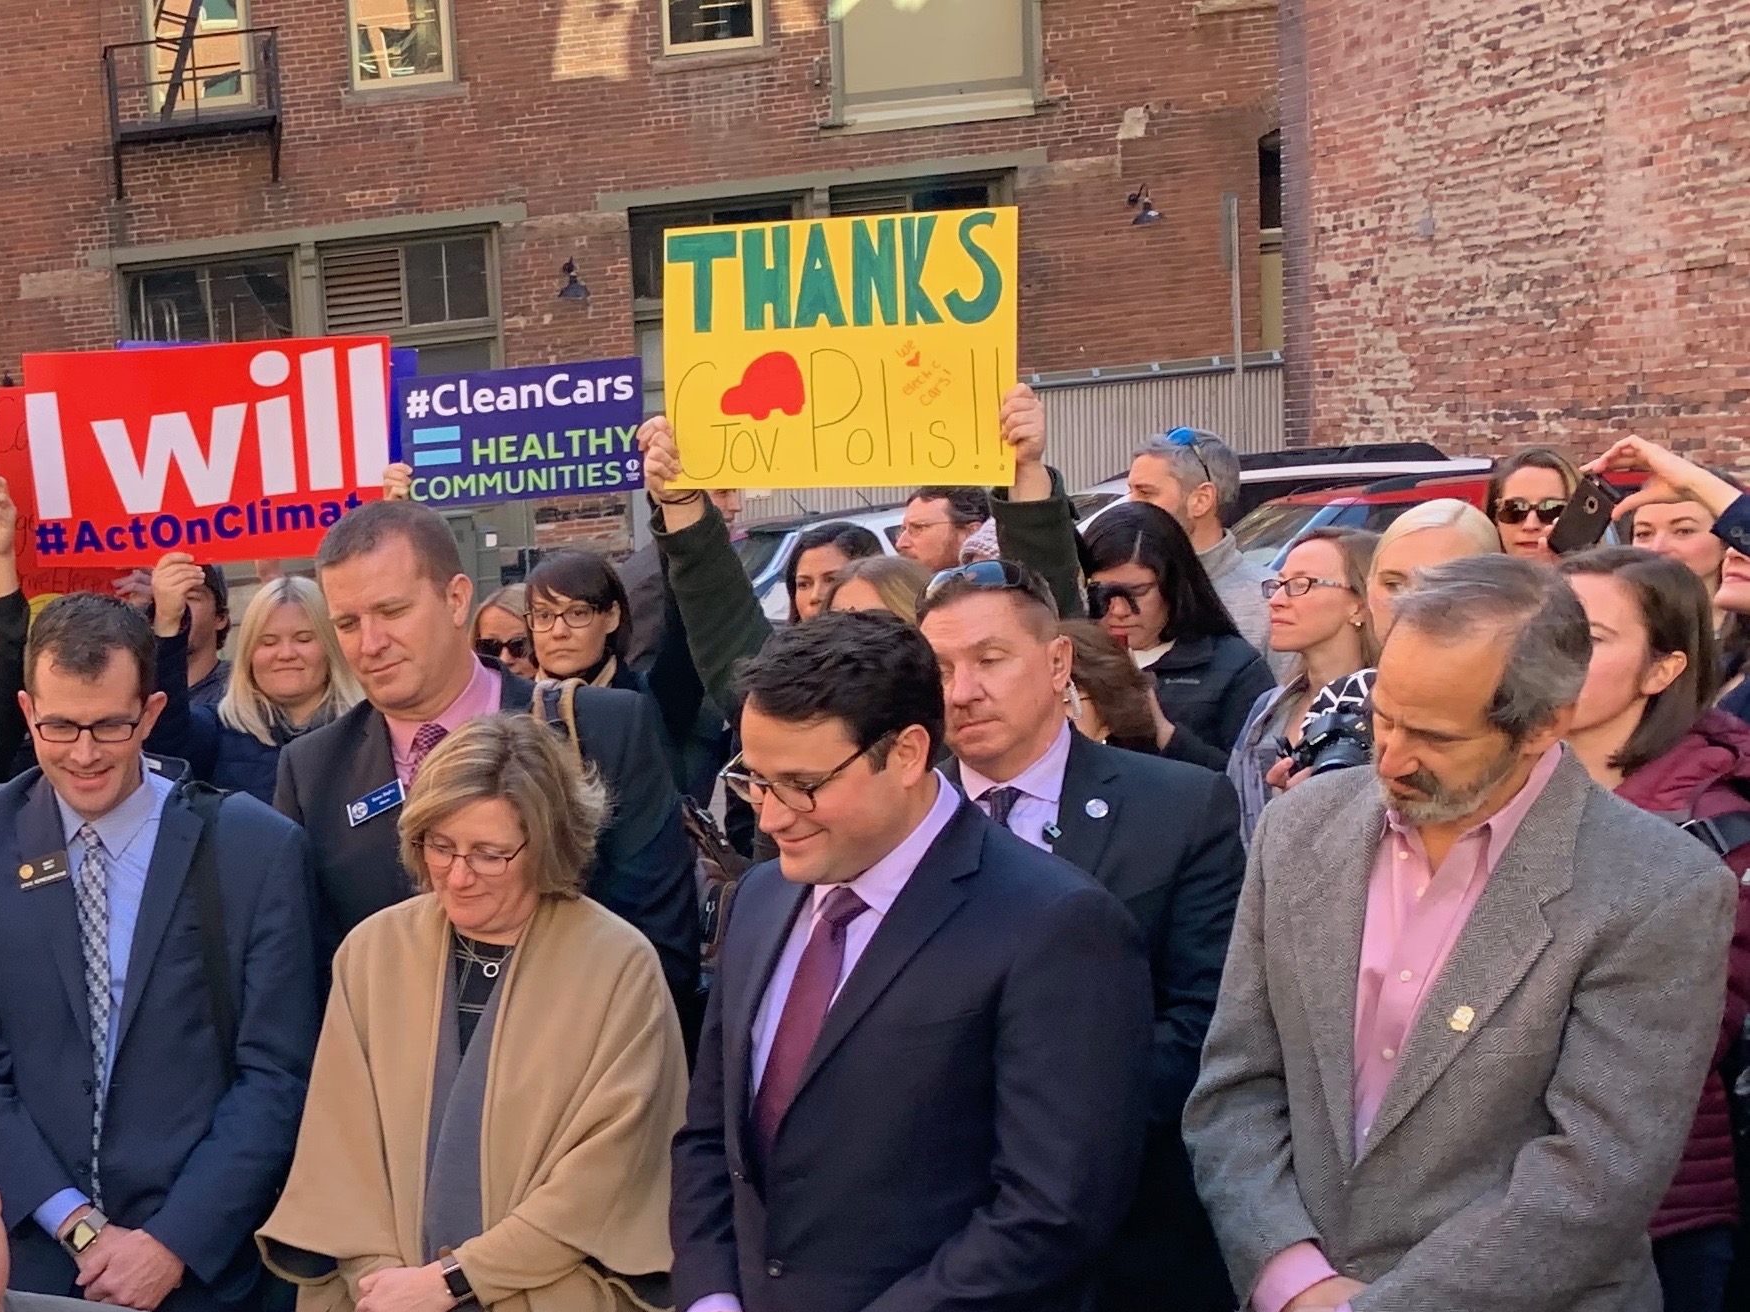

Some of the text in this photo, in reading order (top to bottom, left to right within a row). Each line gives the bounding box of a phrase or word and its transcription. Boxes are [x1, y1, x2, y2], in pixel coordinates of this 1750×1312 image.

[666, 211, 1003, 333] THANKS
[406, 373, 634, 419] #CleanCars
[810, 347, 1006, 473] Polis!!
[24, 342, 390, 521] I will
[472, 424, 639, 466] HEALTHY
[410, 461, 623, 502] COMMUNITIES
[36, 491, 363, 556] #ActOnClimat
